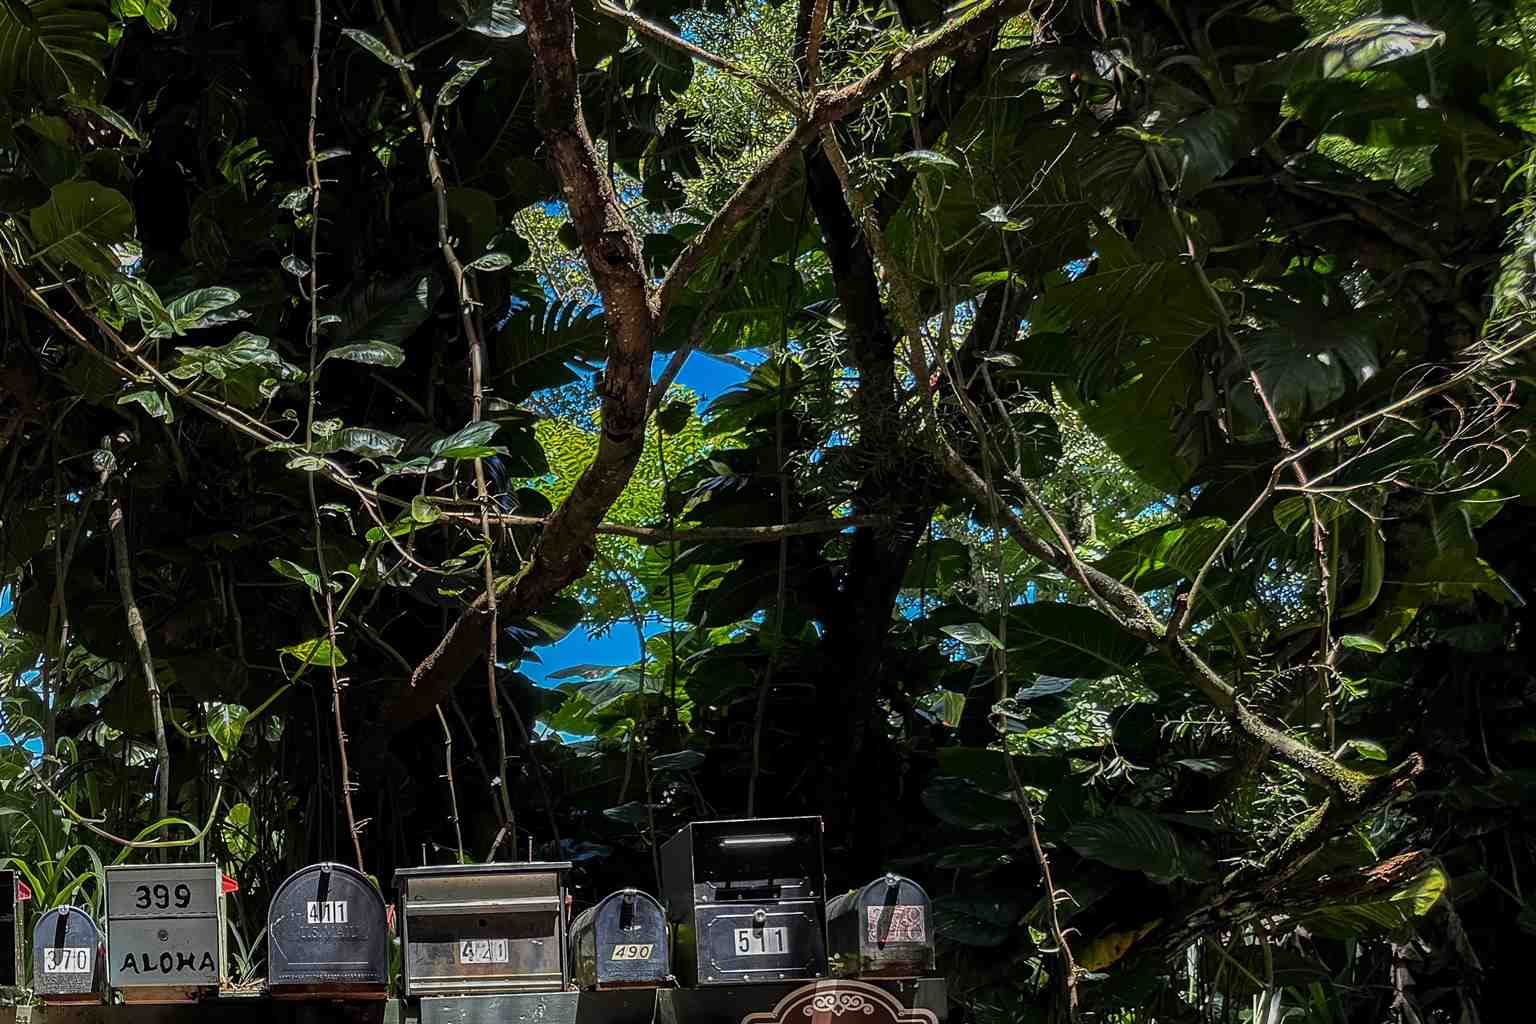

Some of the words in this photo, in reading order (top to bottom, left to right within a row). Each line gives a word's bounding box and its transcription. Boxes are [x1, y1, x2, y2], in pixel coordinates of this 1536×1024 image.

[135, 883, 191, 909] 399
[309, 903, 346, 923] 411
[739, 928, 783, 952] 511
[47, 950, 87, 970] 370
[615, 946, 650, 958] 490
[119, 952, 216, 974] ALOHA
